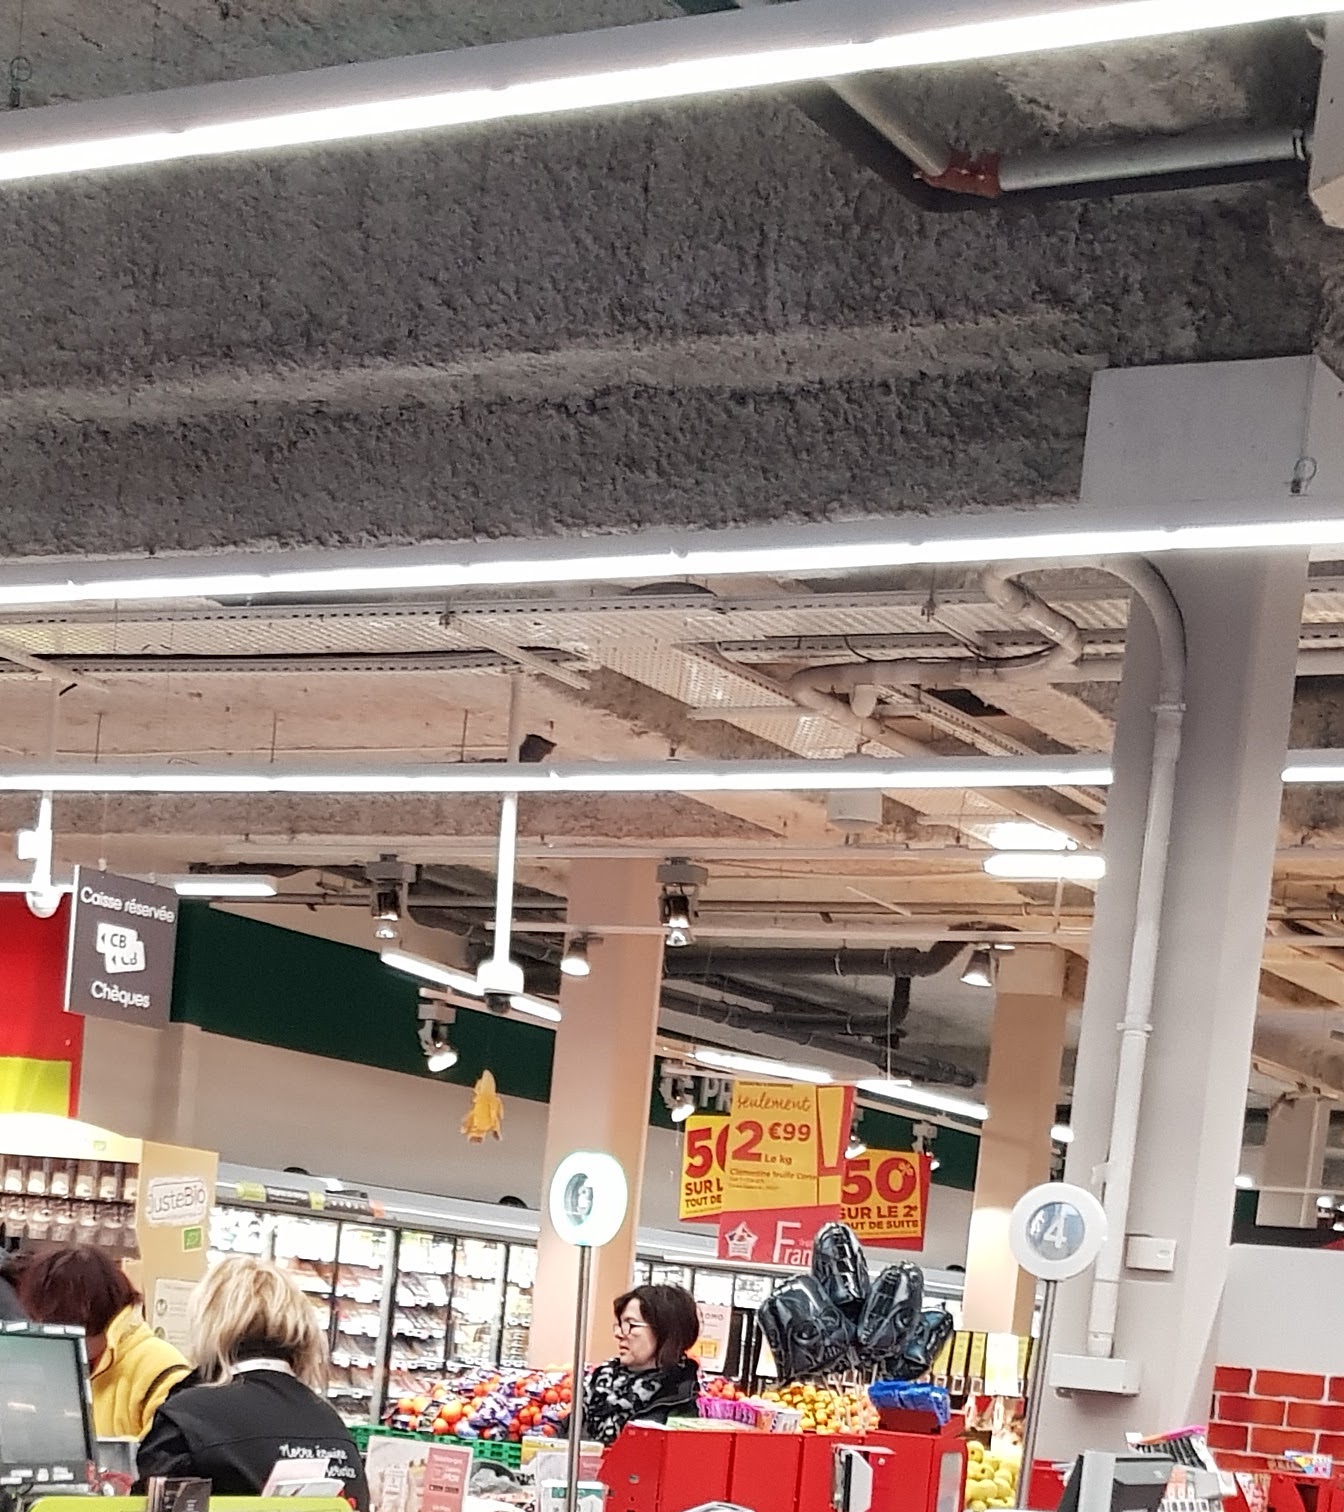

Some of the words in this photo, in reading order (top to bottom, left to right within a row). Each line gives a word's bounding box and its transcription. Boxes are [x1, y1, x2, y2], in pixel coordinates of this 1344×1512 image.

[80, 886, 123, 911] Caisse
[124, 898, 175, 923] réservée
[110, 933, 127, 949] CB
[91, 980, 151, 1008] Chèques
[737, 1092, 811, 1112] seulement
[764, 1154, 777, 1164] Le
[779, 1154, 793, 1166] kg
[685, 1179, 714, 1196] SUR
[685, 1197, 708, 1208] TOUT
[876, 1206, 899, 1218] LE
[868, 1221, 884, 1229] DE
[886, 1219, 918, 1229] SUITE
[1043, 1213, 1067, 1249] 4
